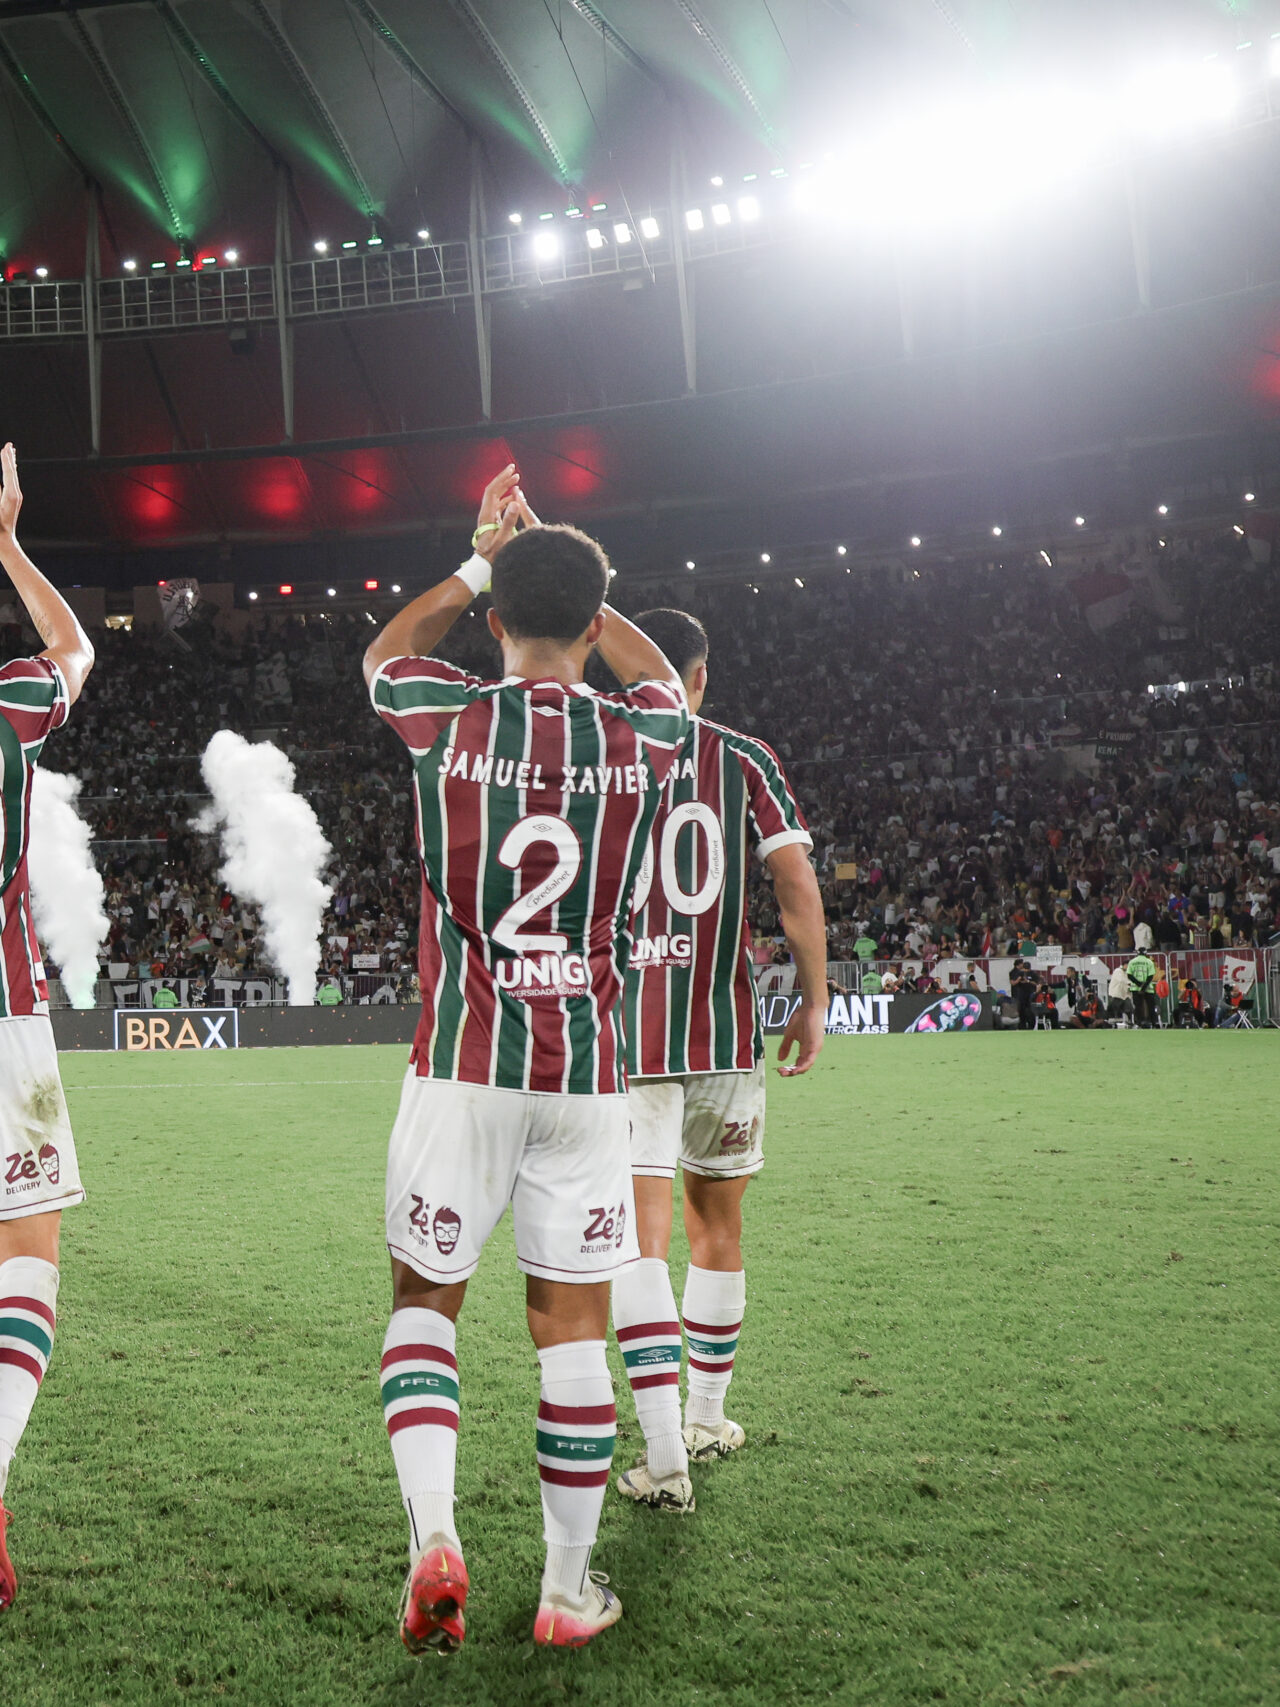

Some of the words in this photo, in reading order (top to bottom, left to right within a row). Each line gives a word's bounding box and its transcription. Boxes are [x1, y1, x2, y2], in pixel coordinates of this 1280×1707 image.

[438, 747, 547, 790] SAMUEL
[560, 762, 649, 795] XAVIER
[669, 757, 698, 780] NA
[491, 814, 582, 952] 2
[530, 870, 571, 906] predialnet
[628, 934, 691, 962] UNIG
[496, 954, 585, 989] UNIG
[125, 1016, 229, 1050] BRAX
[720, 1120, 749, 1148] Zé
[4, 1150, 40, 1185] Zé
[5, 1180, 42, 1196] DELIVERY
[583, 1205, 616, 1242] Zé
[400, 1377, 440, 1388] FFC
[557, 1440, 598, 1452] FFC
